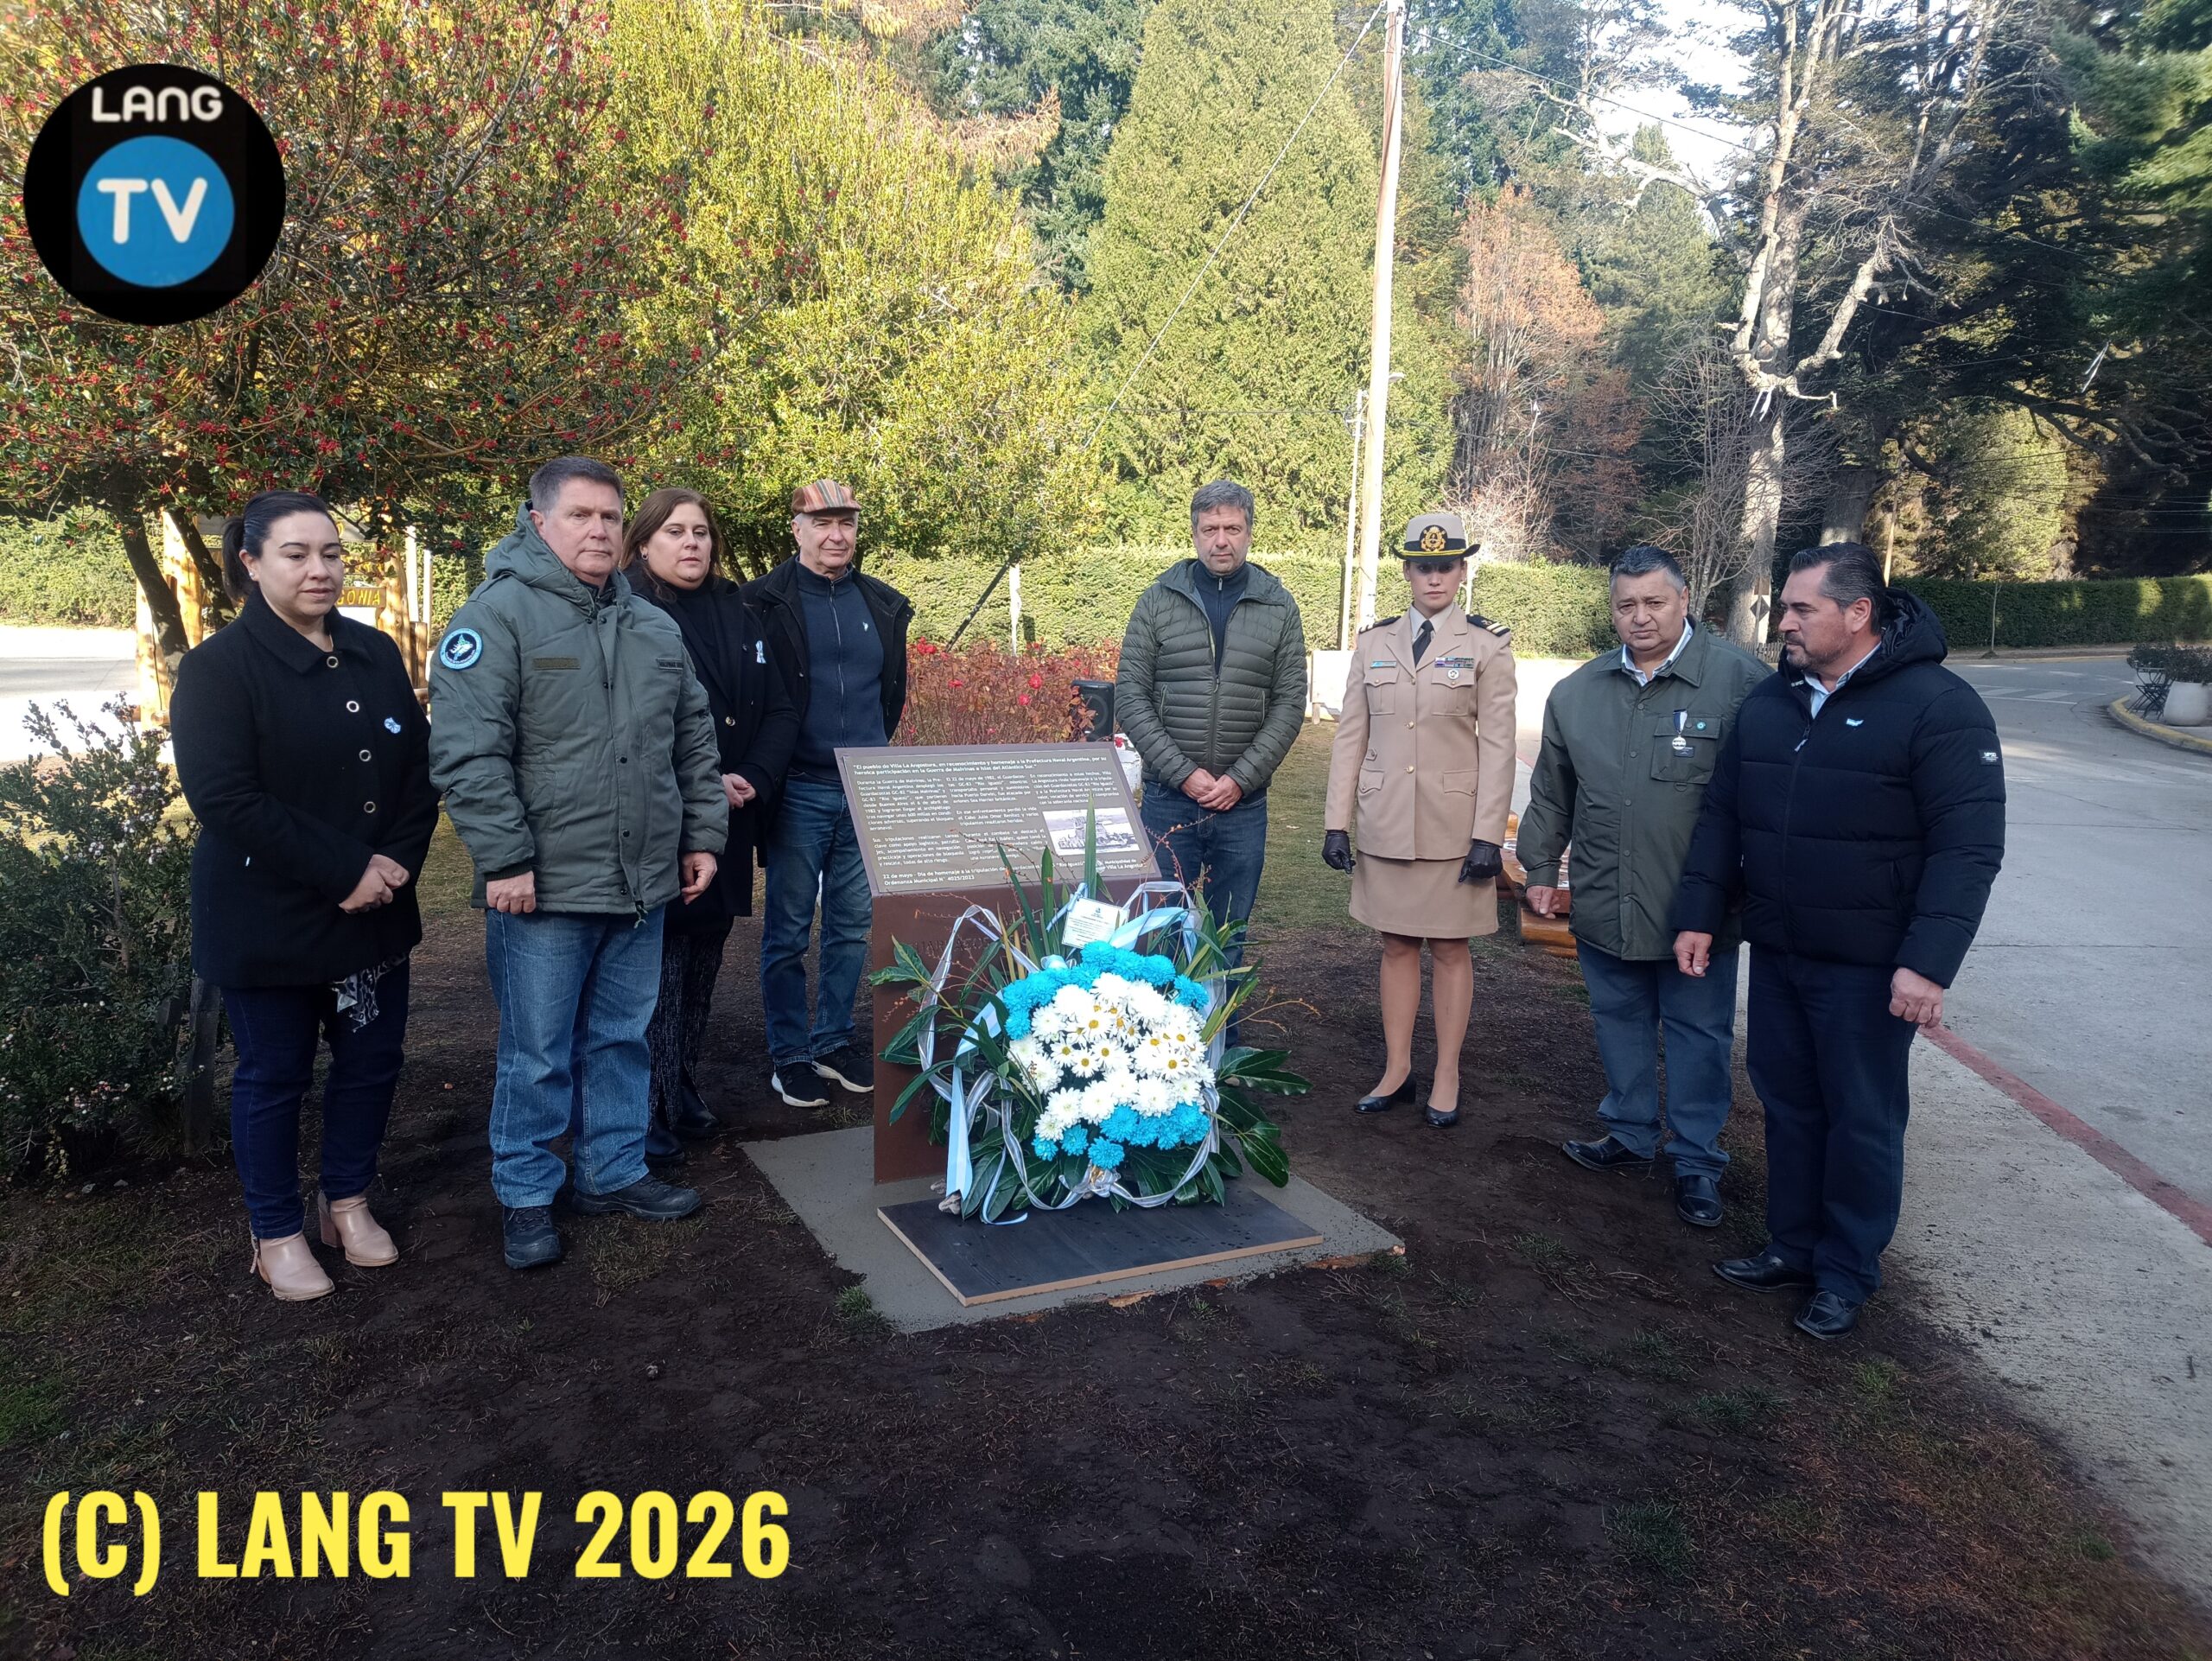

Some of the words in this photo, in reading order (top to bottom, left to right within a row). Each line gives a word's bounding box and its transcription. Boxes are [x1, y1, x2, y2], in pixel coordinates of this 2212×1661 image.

[336, 589, 381, 606] GONIA
[934, 869, 960, 877] homenaje
[971, 866, 998, 875] tripulación
